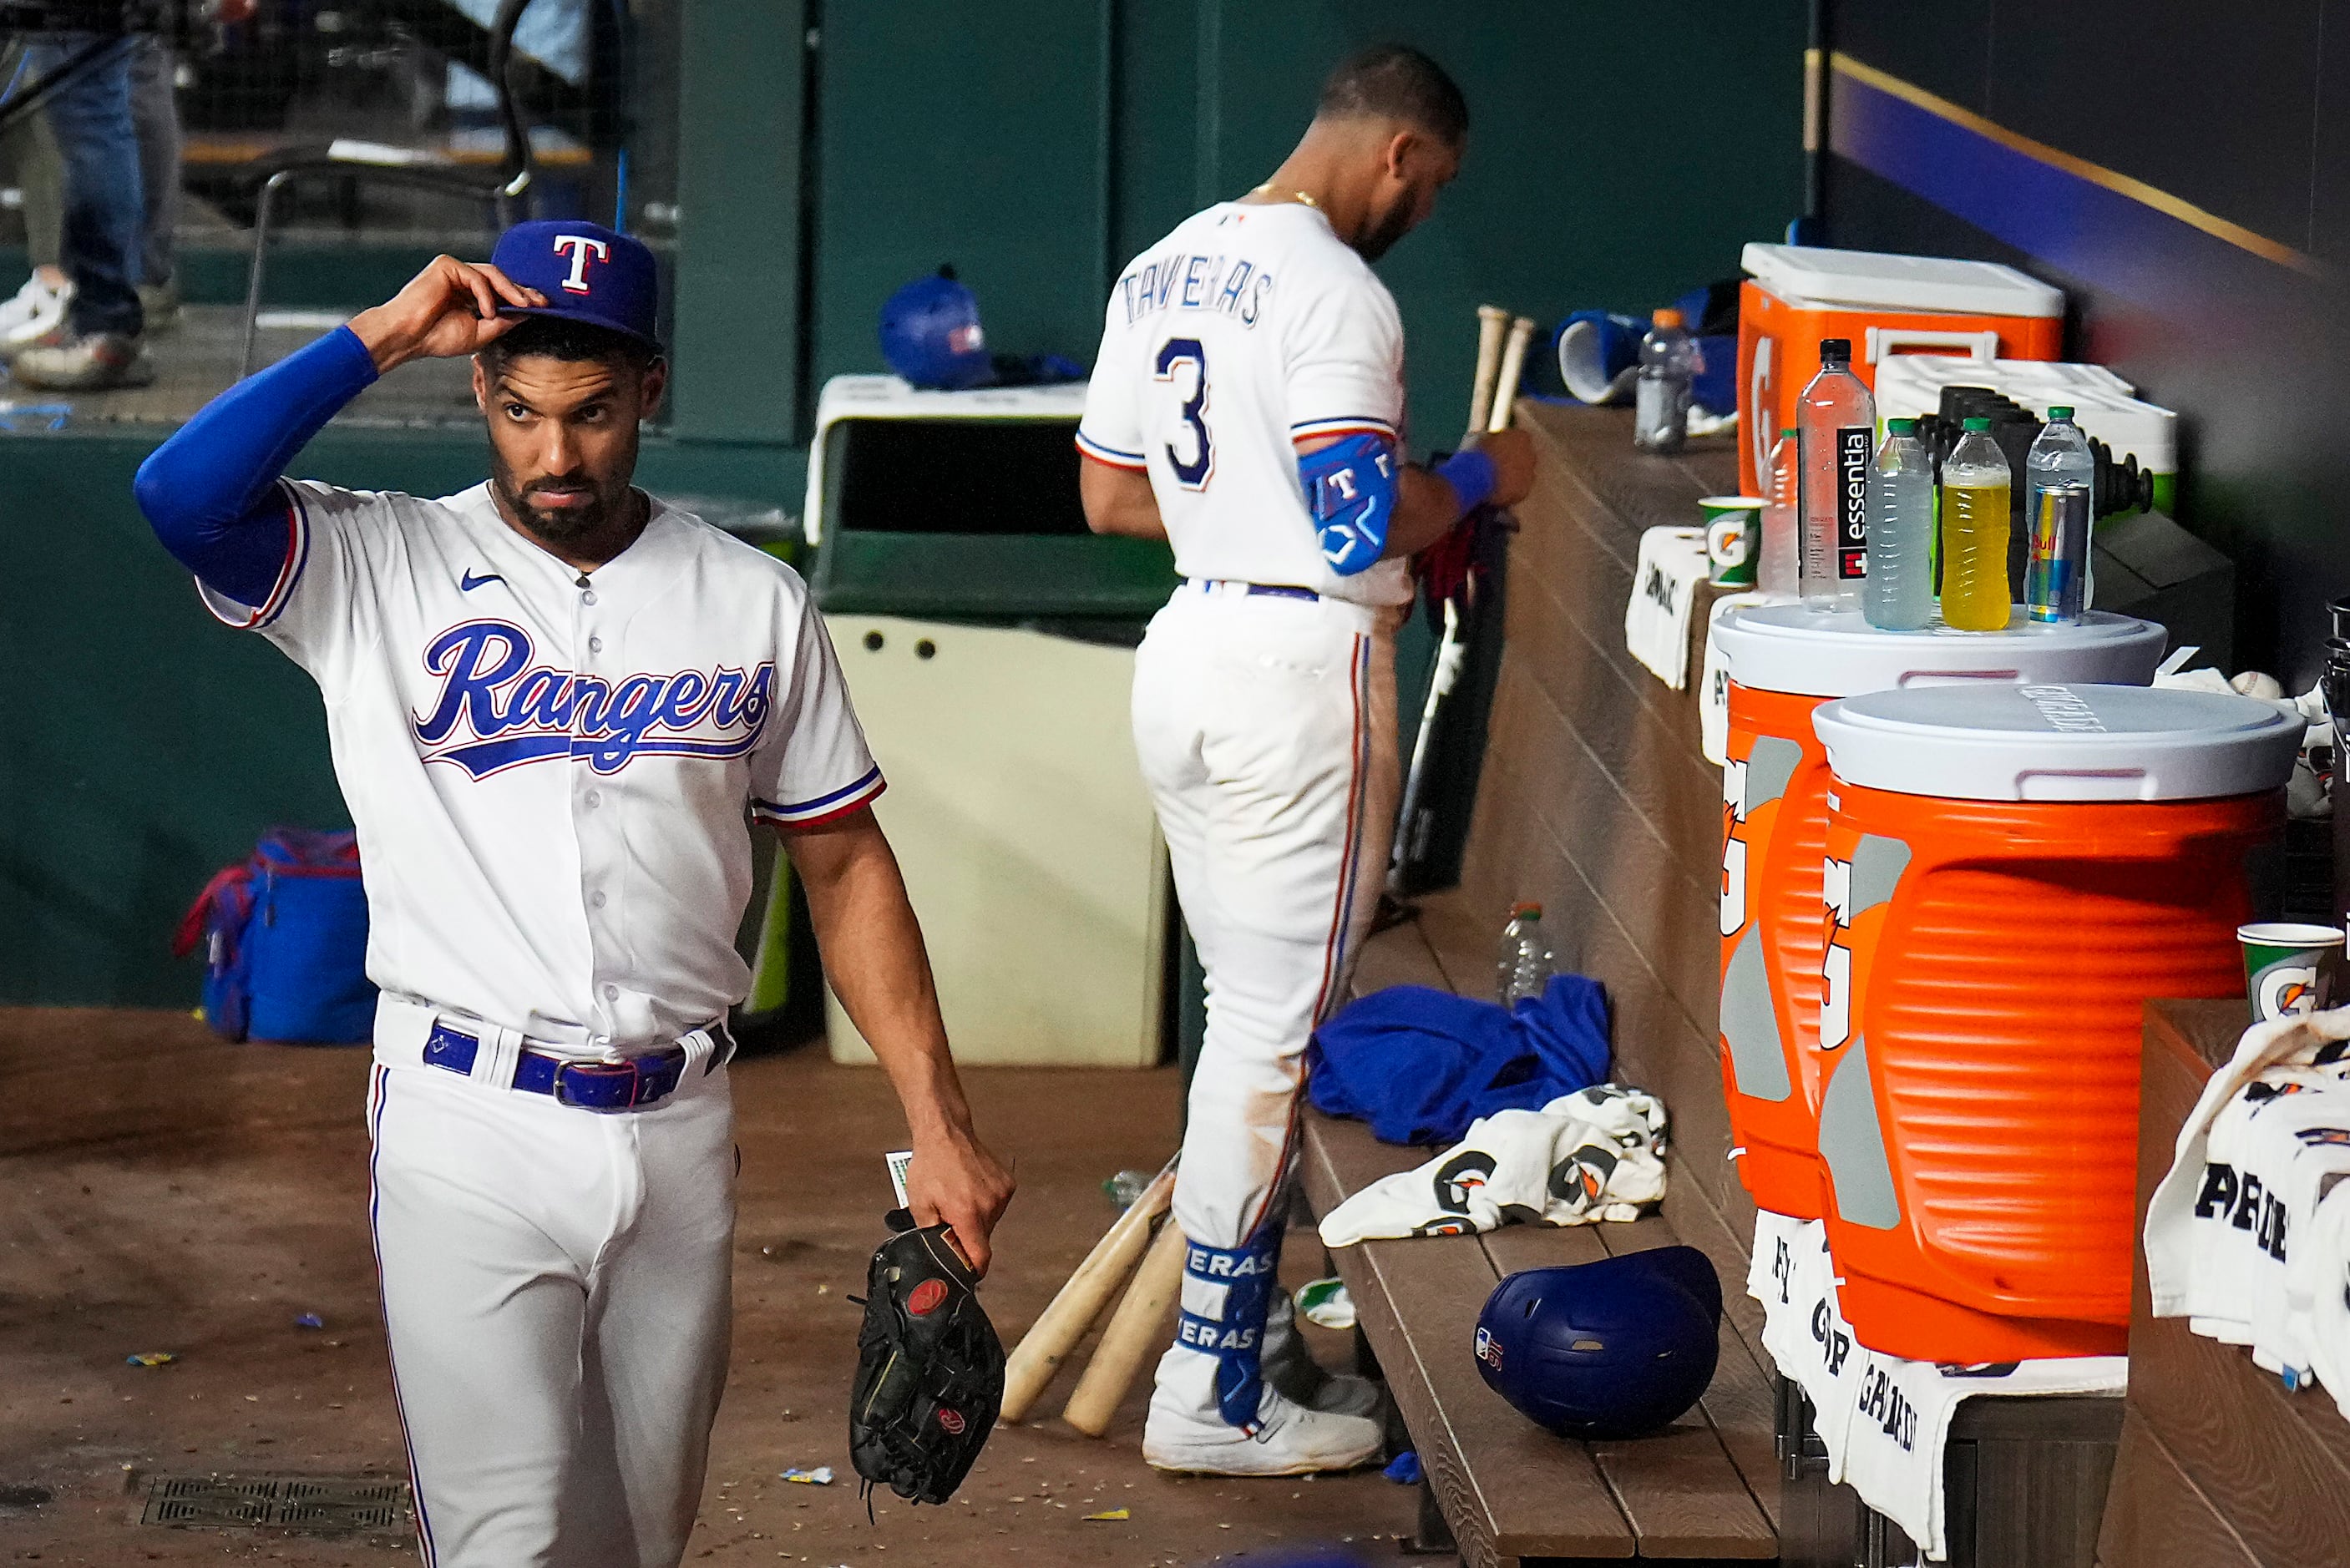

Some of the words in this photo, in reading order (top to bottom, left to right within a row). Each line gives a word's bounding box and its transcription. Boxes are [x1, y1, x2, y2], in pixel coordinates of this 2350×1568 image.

[554, 235, 610, 296] T
[1153, 336, 1215, 493] 3
[1328, 468, 1357, 499] T
[1844, 433, 1866, 540] essentia
[1708, 519, 1746, 568] G
[413, 618, 775, 781] Rangers
[2258, 966, 2317, 1020] G
[1187, 1247, 1273, 1277] ERAS
[1178, 1318, 1255, 1349] ERAS
